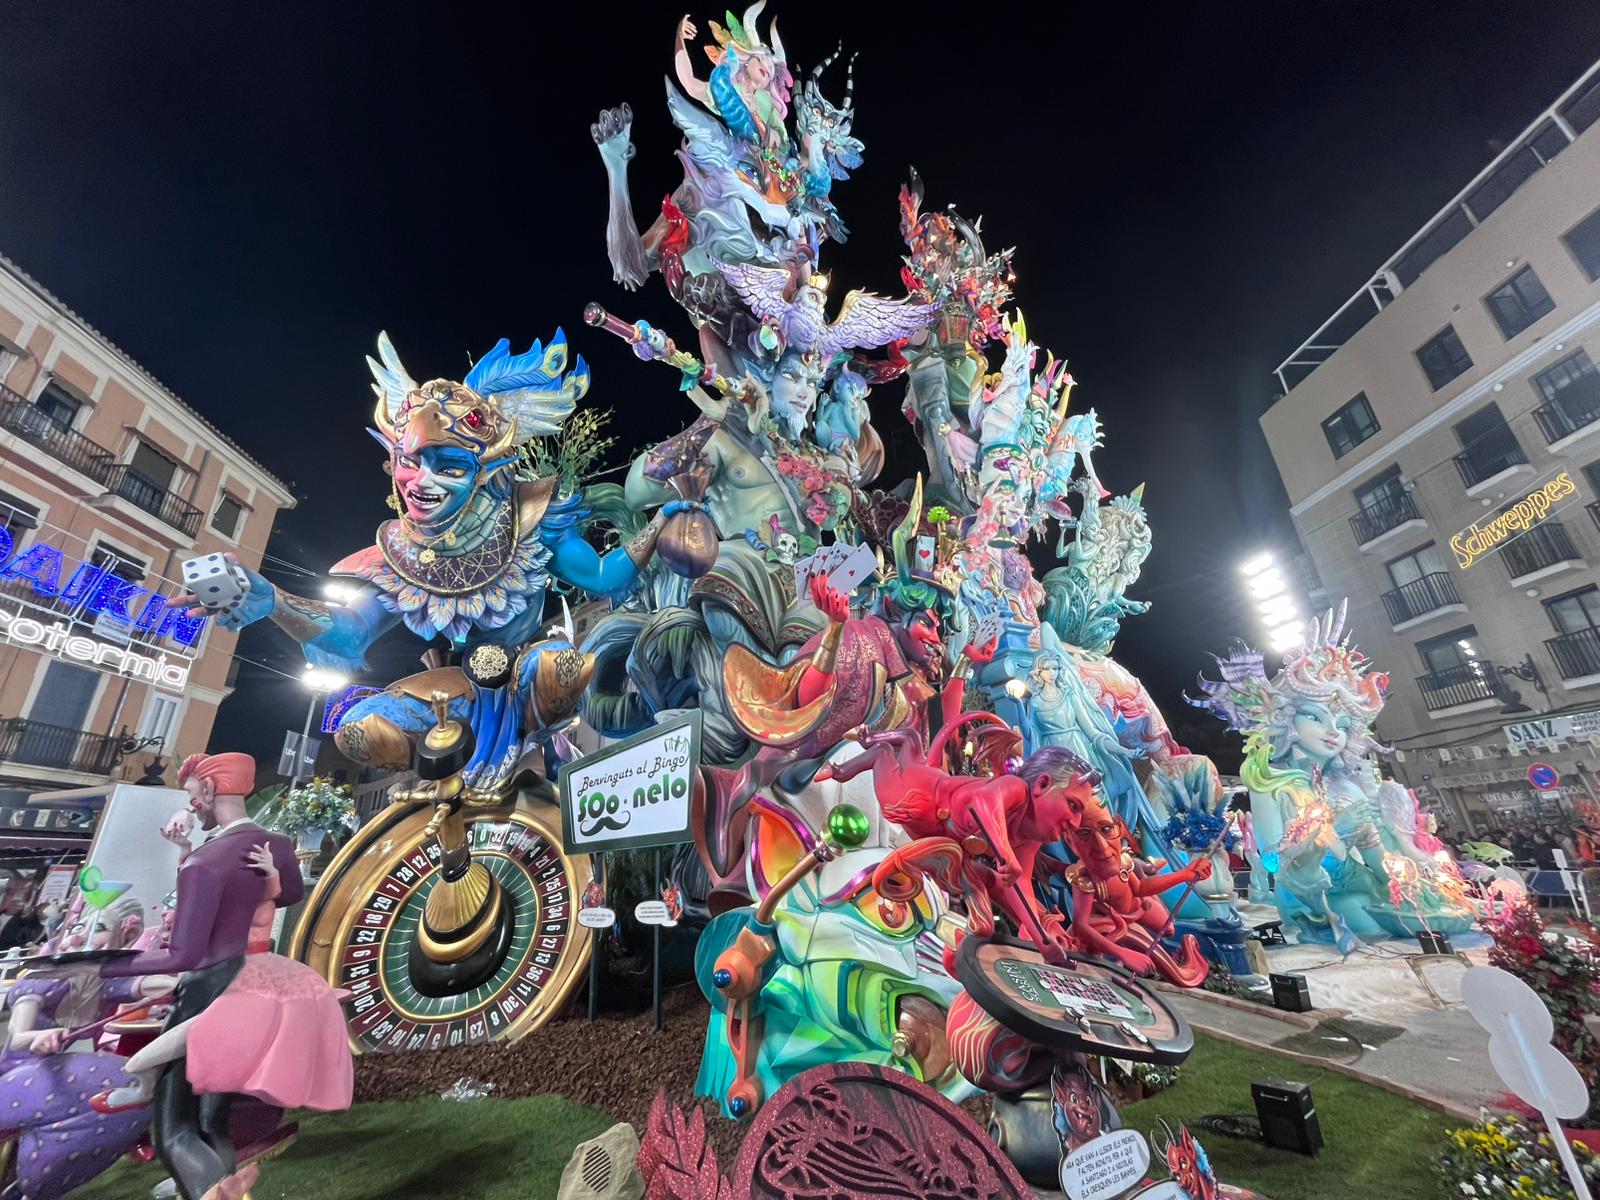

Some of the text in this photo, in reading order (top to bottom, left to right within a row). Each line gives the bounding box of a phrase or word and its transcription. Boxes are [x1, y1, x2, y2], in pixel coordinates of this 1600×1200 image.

[1449, 472, 1575, 569] Schweppes
[1509, 719, 1557, 742] SANZ
[577, 750, 690, 797] Benvinguts al Bingo
[480, 829, 487, 841] 0
[492, 830, 502, 842] 32
[506, 831, 518, 846] 15
[427, 844, 441, 860] 35
[529, 846, 541, 858] 4
[411, 855, 427, 869] 12
[535, 855, 551, 869] 21
[396, 866, 414, 882] 28
[542, 867, 556, 878] 2
[545, 879, 561, 891] 25
[373, 896, 392, 911] 29
[548, 892, 562, 903] 17
[364, 913, 383, 925] 18
[548, 907, 563, 919] 34
[546, 924, 560, 932] 6
[356, 929, 377, 943] 22
[541, 938, 557, 949] 27
[352, 949, 371, 958] 9
[535, 952, 551, 964] 13
[350, 963, 370, 978] 31
[526, 966, 543, 982] 36
[351, 979, 371, 995] 14
[516, 982, 532, 997] 11
[354, 994, 375, 1013] 20
[502, 995, 519, 1013] 30
[362, 1011, 380, 1024] 1
[490, 1011, 500, 1026] 8
[371, 1020, 393, 1039] 33
[388, 1028, 408, 1046] 16
[450, 1028, 463, 1046] 10
[469, 1020, 484, 1039] 23
[406, 1033, 426, 1050] 24
[431, 1033, 441, 1049] 5
